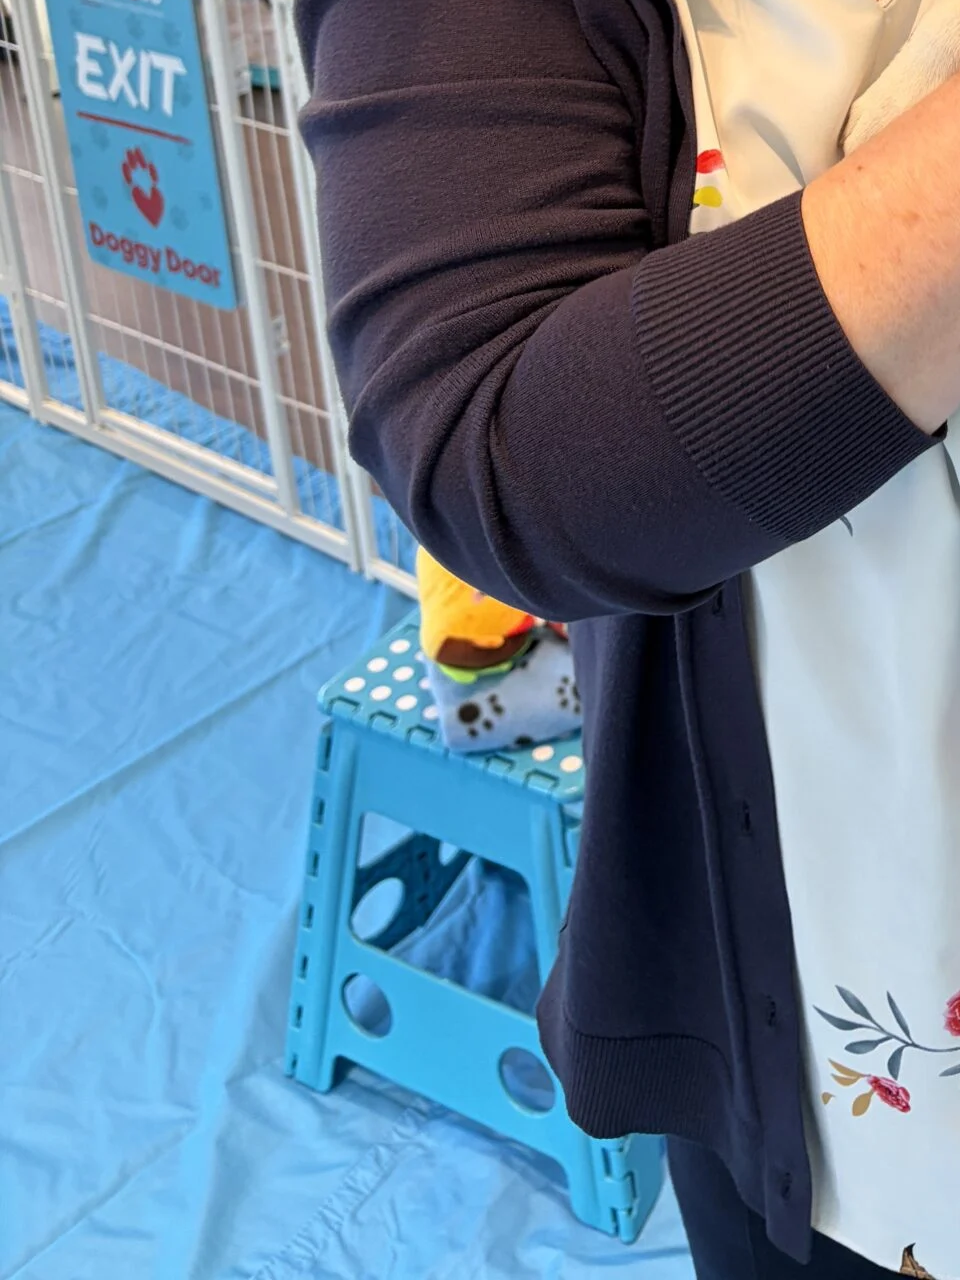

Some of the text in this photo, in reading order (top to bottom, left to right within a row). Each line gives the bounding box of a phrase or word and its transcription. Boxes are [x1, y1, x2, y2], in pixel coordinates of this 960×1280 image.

[75, 31, 187, 118] EXIT
[89, 220, 220, 288] Doggy Door
